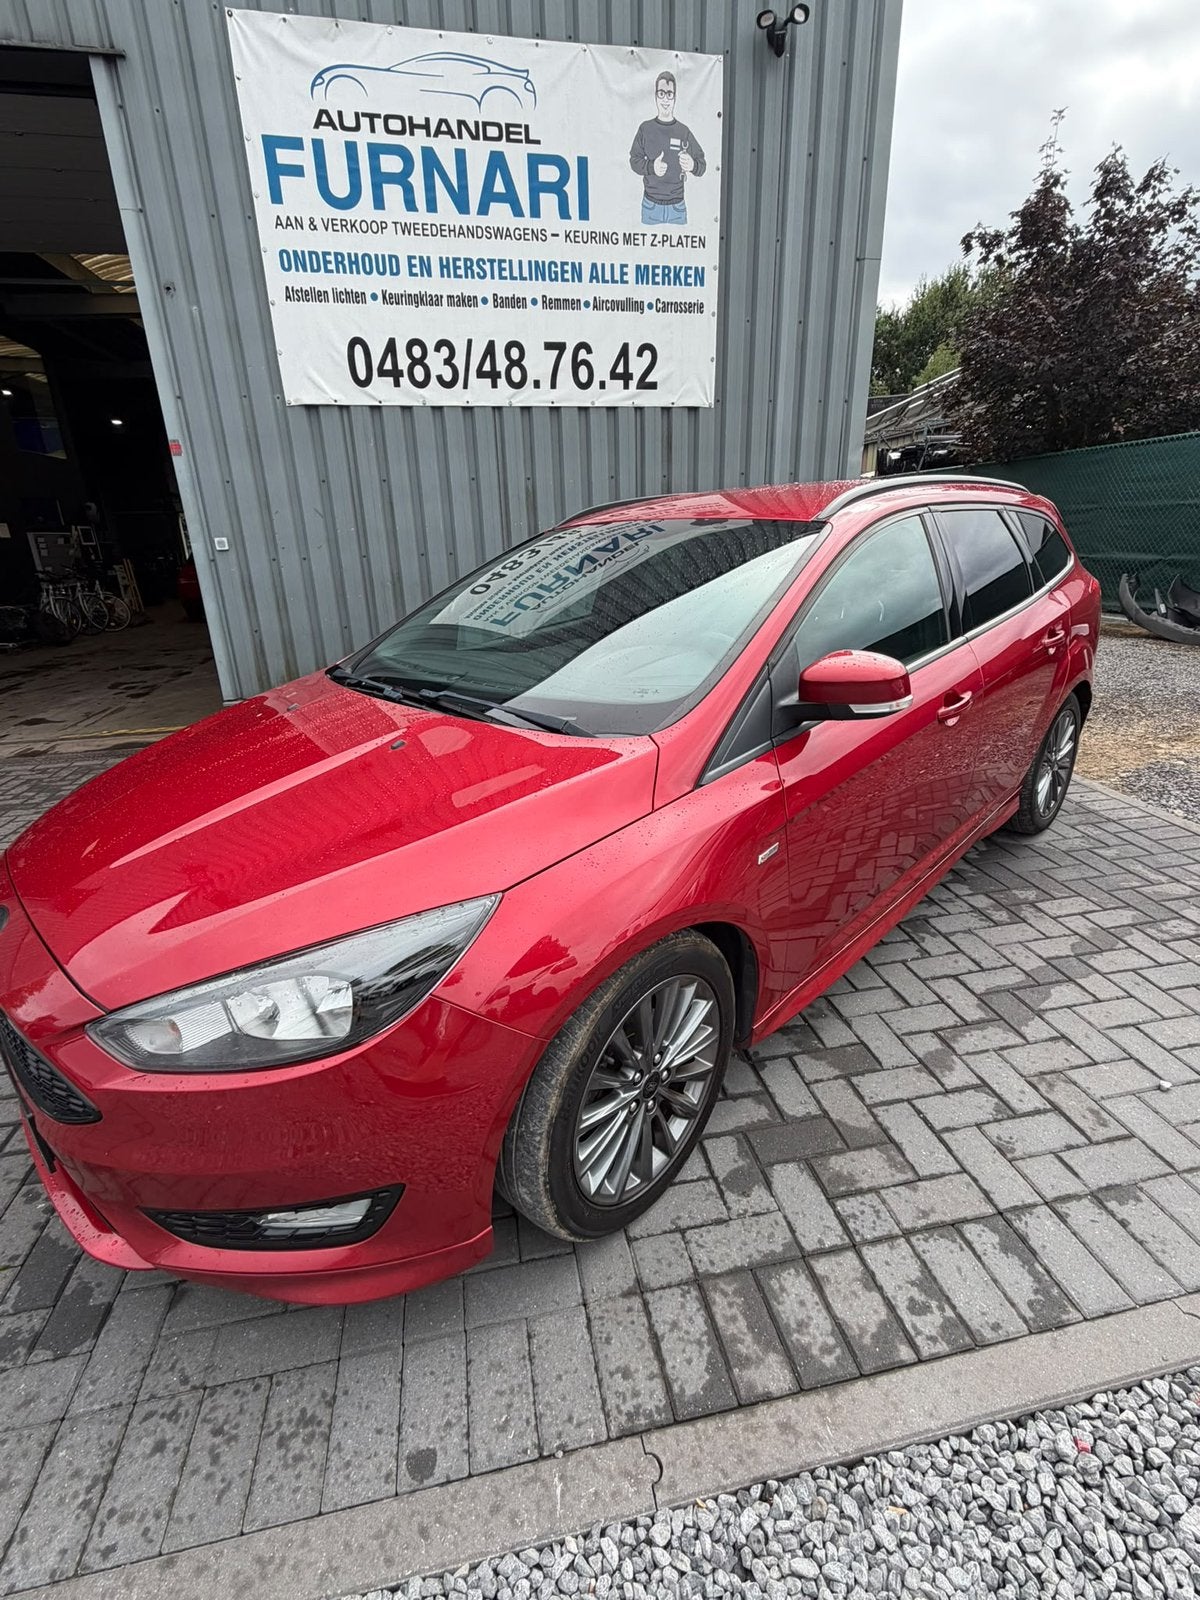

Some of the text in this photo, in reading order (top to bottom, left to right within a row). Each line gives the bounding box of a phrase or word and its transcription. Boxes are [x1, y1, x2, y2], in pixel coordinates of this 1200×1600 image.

[312, 108, 542, 146] AUTOHANDEL
[260, 133, 591, 222] FURNARI
[274, 214, 304, 231] AAN
[308, 216, 318, 232] &
[320, 217, 388, 235] VERKOOP
[391, 221, 548, 243] TWEEDEHANDSWAGENS
[564, 229, 619, 246] KEURING
[622, 232, 648, 247] MET
[650, 234, 706, 249] Z-PLATEN
[278, 248, 706, 287] ONDERHOUD EN HERSTELLINGEN ALLE MERKEN
[331, 287, 367, 305] lichten
[381, 288, 444, 309] Keuringklaar
[446, 291, 479, 308] maken
[492, 293, 528, 310] Banden
[541, 294, 582, 311] Remmen
[592, 295, 645, 315] Aircovulling
[655, 297, 705, 315] Carrosserie
[346, 336, 658, 391] 0483/48.76.42
